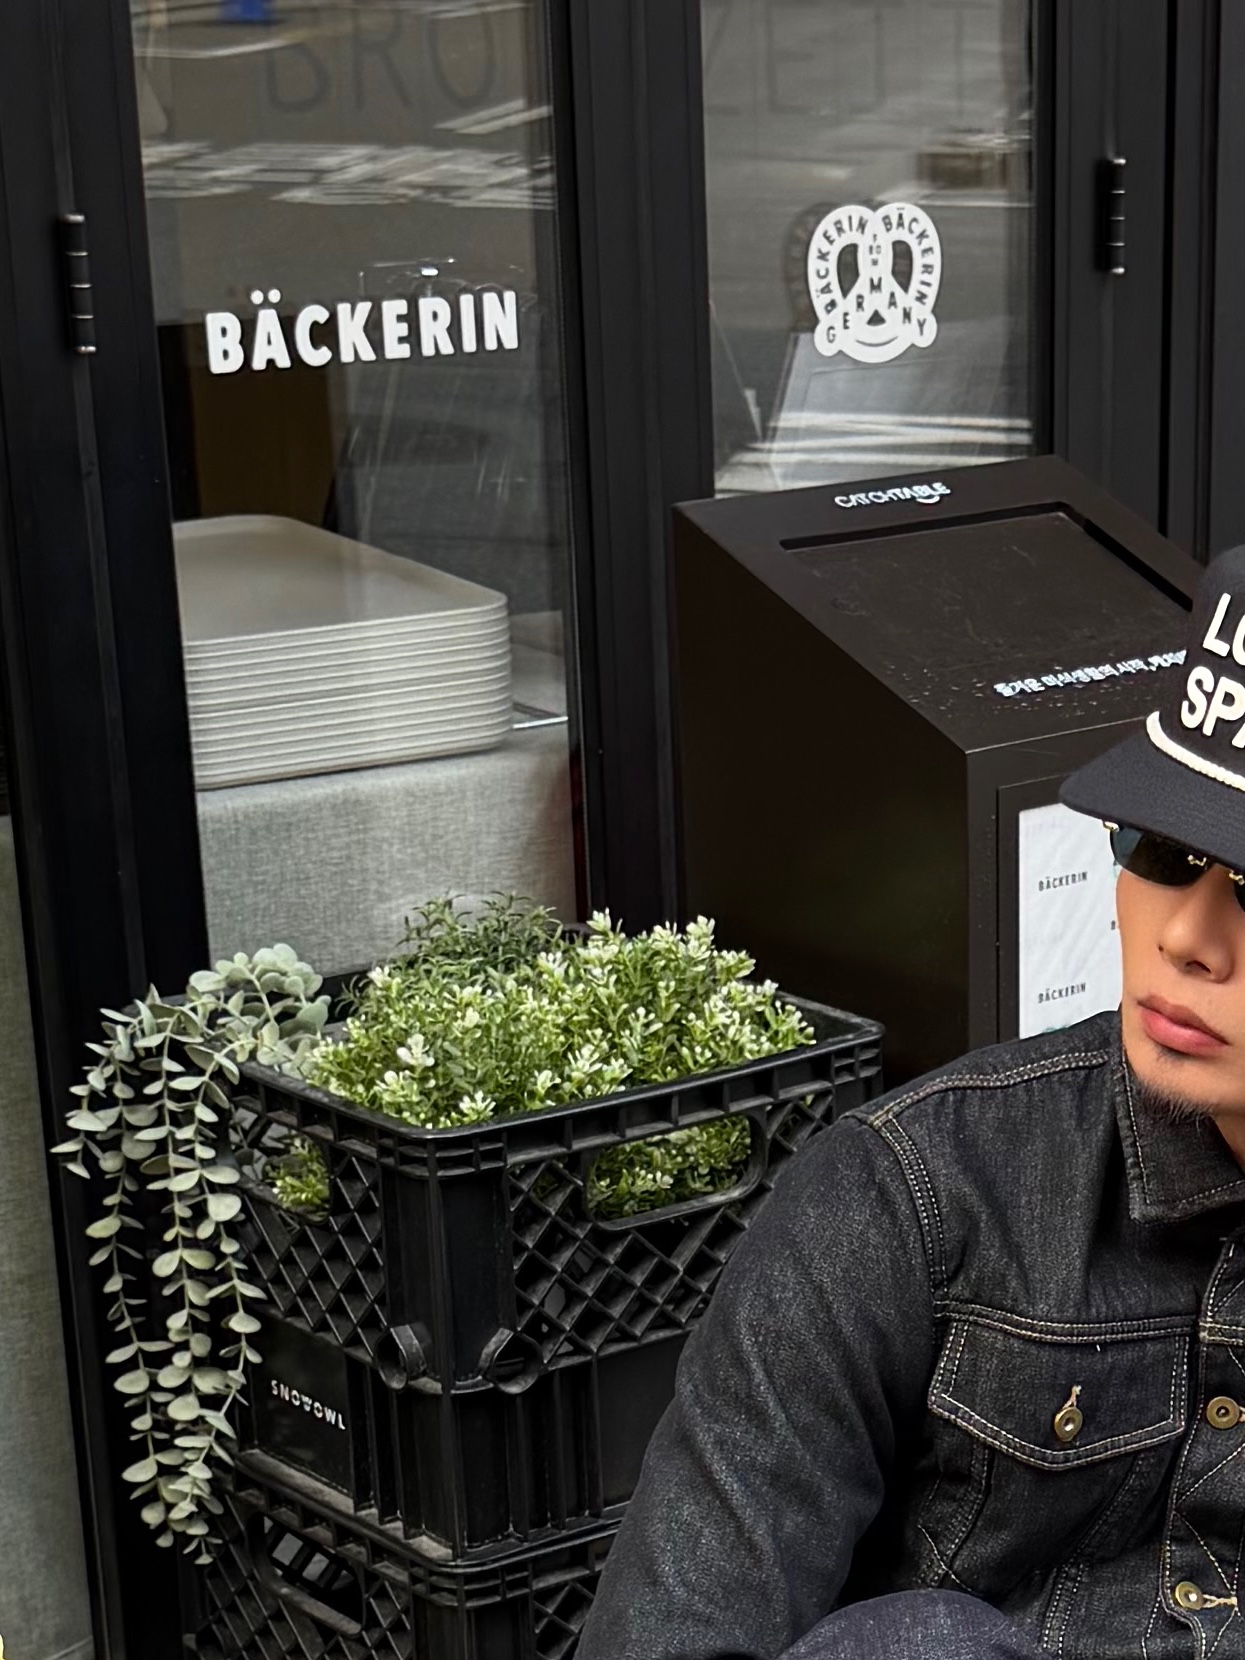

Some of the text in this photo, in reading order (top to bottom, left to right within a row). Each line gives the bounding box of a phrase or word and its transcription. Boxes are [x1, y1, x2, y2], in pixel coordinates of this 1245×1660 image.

[816, 215, 868, 314] BÄCKERIN
[882, 207, 934, 305] BÄCKERIN
[205, 288, 520, 375] BÄCKERIN
[826, 277, 927, 343] GERMANY
